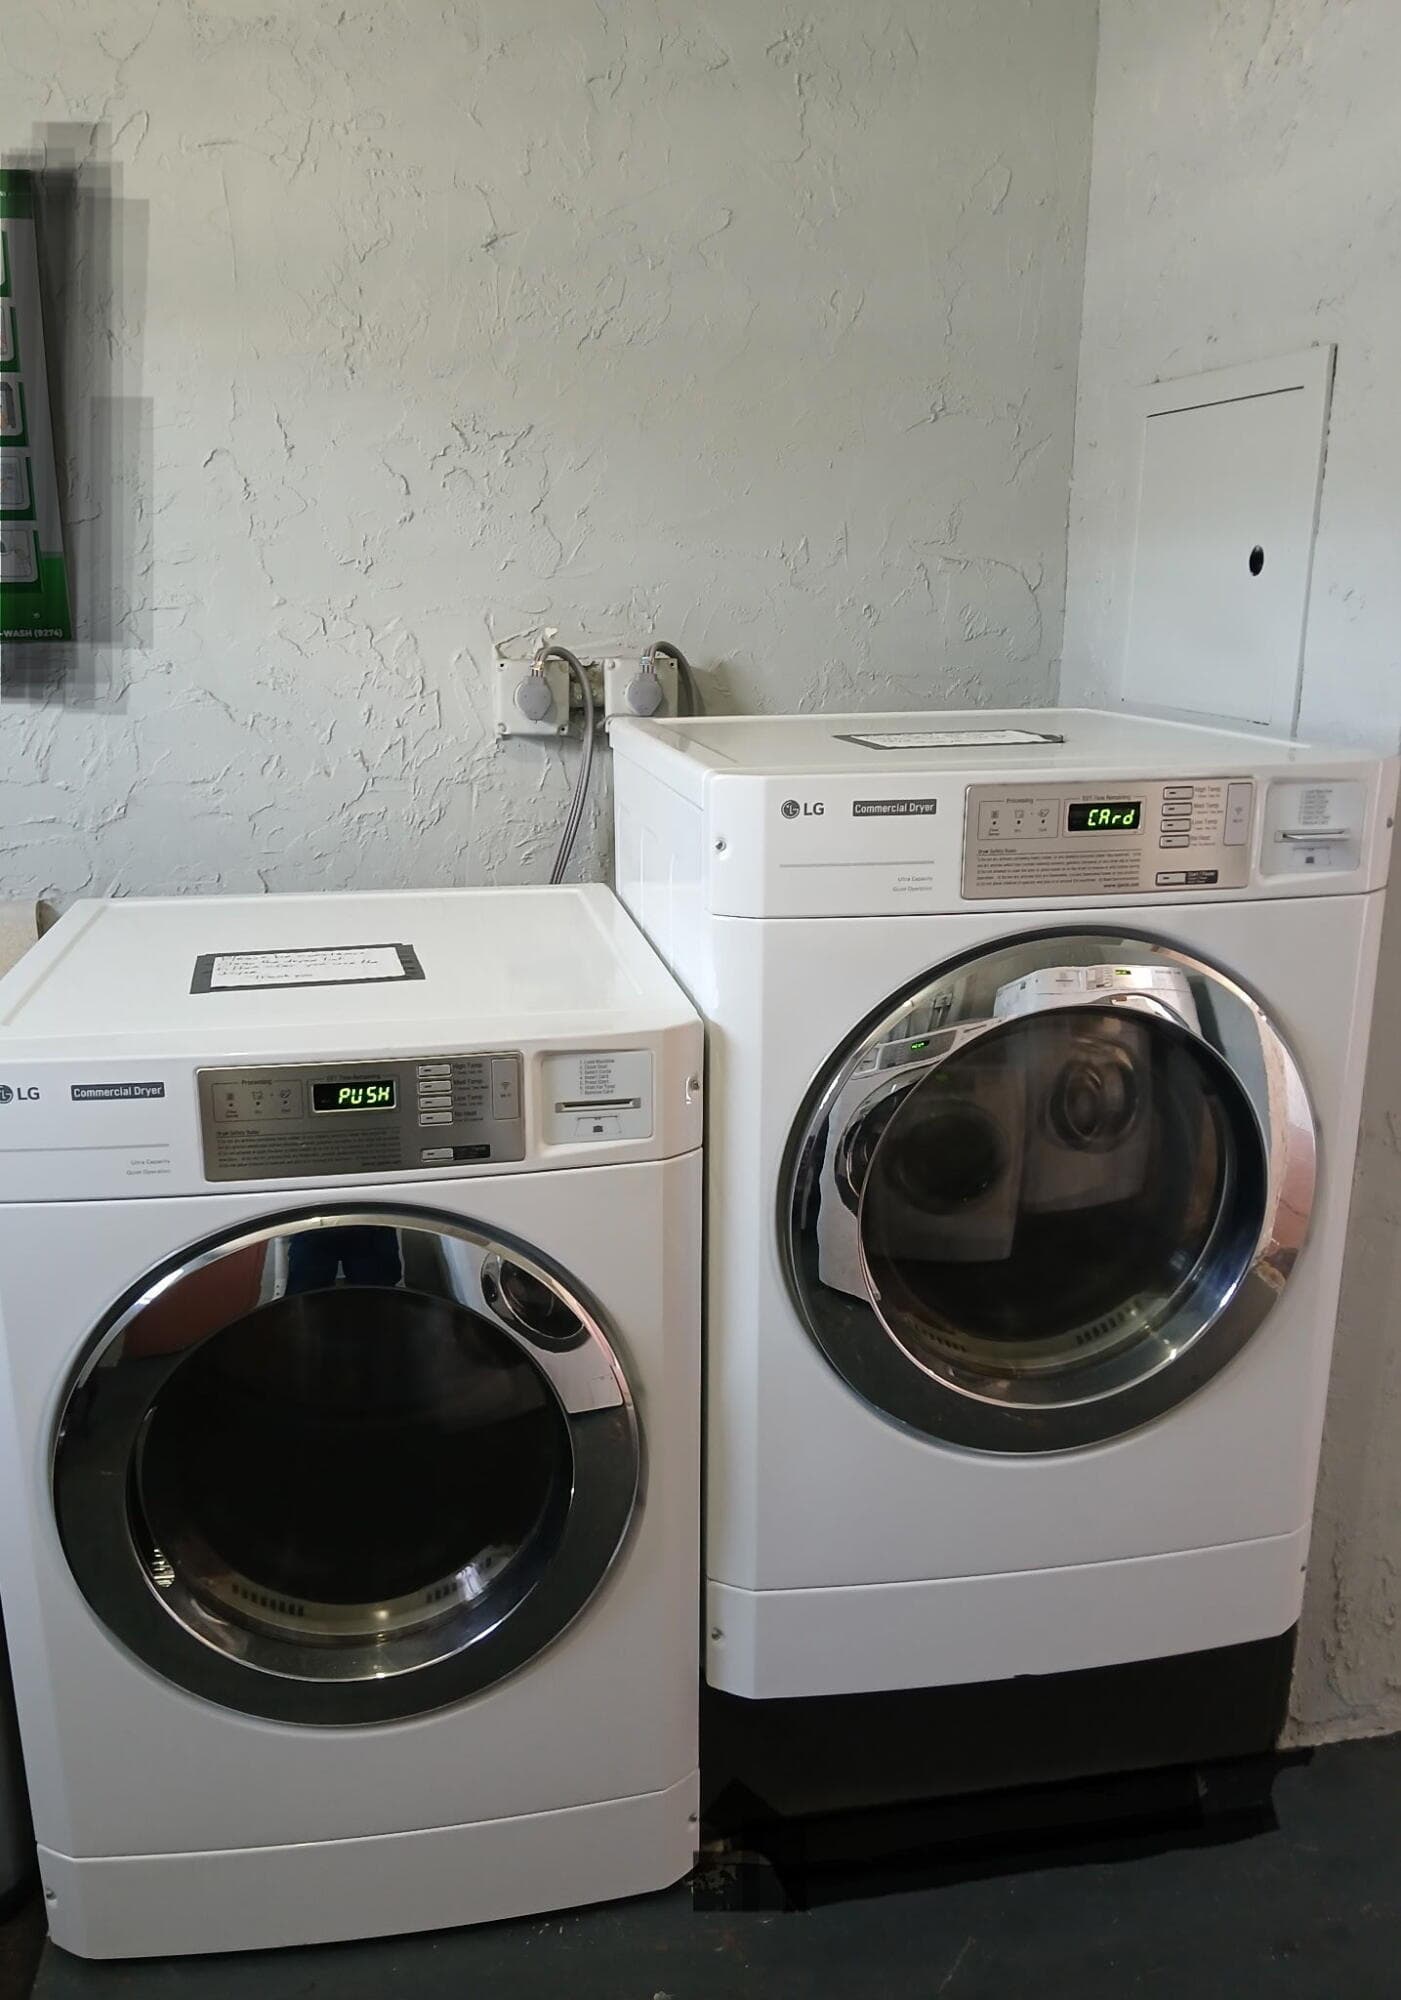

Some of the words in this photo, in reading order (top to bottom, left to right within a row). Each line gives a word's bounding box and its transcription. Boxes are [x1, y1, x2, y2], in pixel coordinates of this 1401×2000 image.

[34, 628, 63, 638] (9274)
[803, 802, 825, 816] LG
[854, 803, 907, 814] Commercial
[909, 802, 935, 813] Dryer
[17, 1087, 41, 1100] LG
[73, 1086, 132, 1099] Commercial
[133, 1085, 162, 1097] Dryer
[338, 1086, 391, 1105] PUSH
